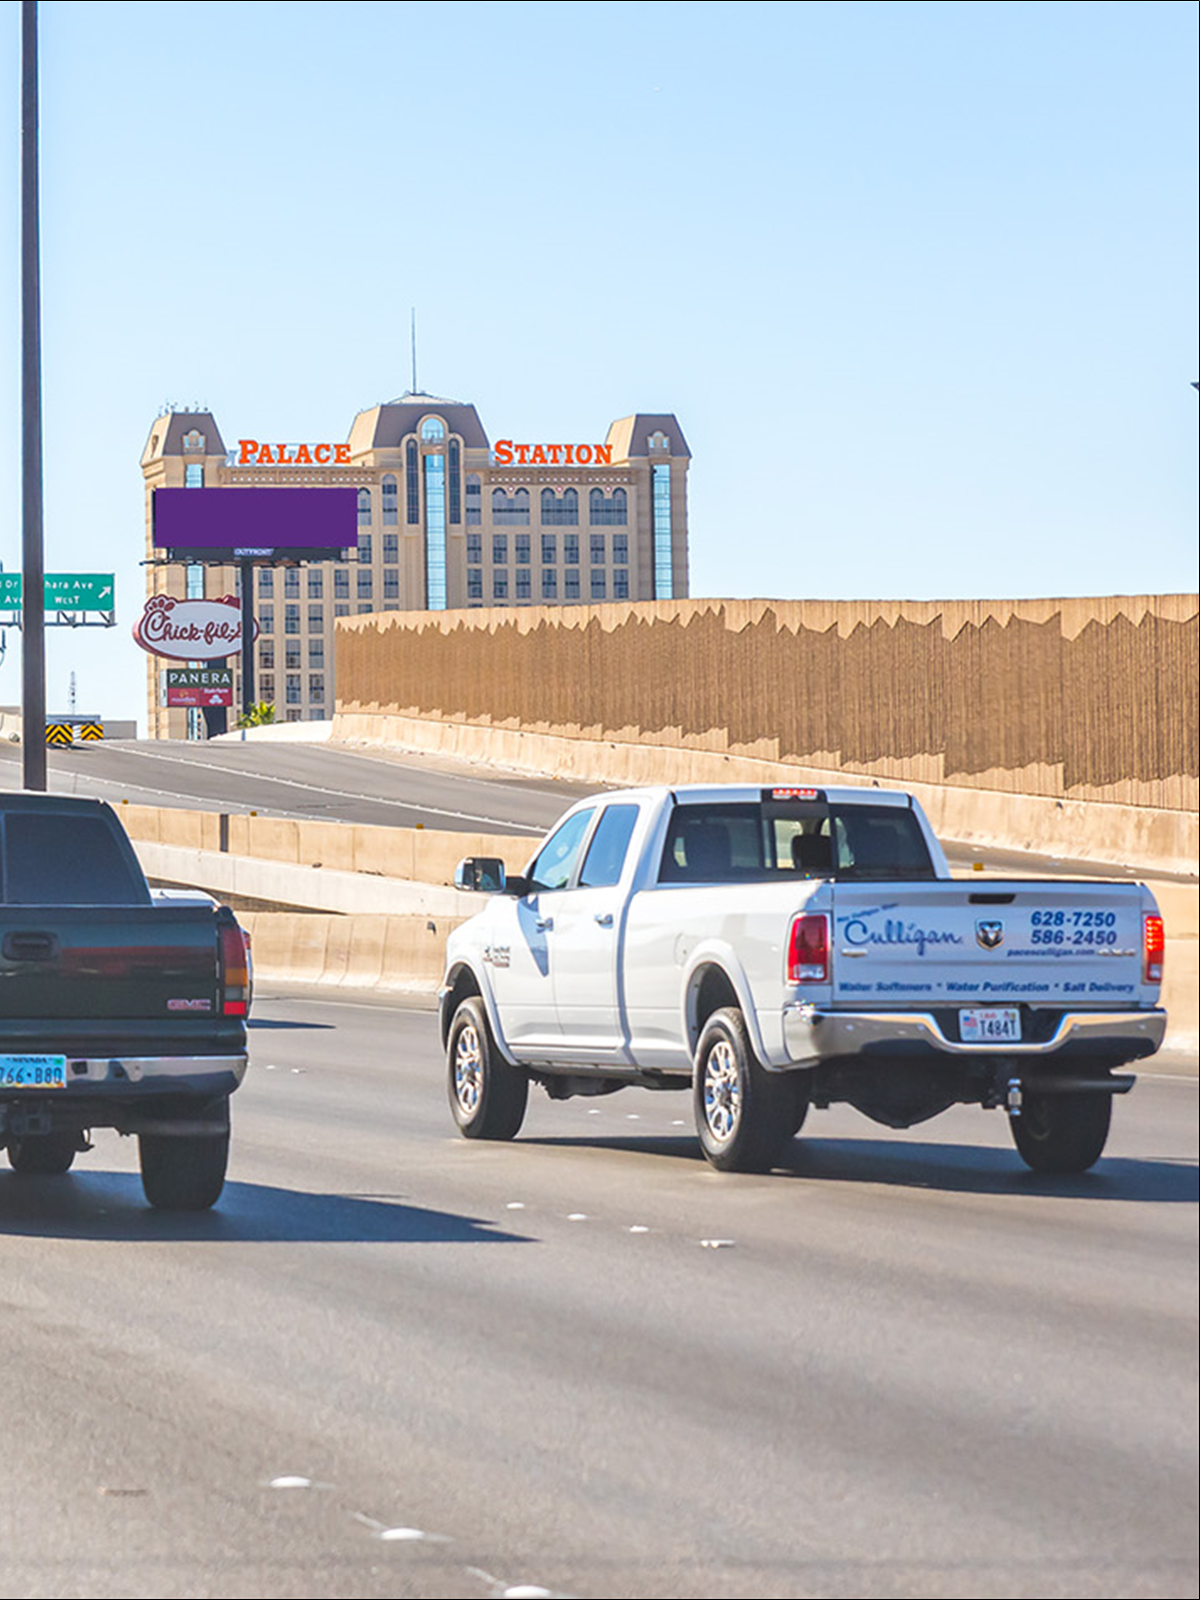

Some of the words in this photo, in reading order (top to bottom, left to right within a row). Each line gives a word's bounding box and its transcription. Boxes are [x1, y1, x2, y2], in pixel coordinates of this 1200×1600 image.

[238, 439, 352, 464] PALACE
[494, 439, 613, 465] STATION
[45, 580, 69, 590] hara
[72, 580, 94, 590] Ave
[169, 672, 231, 684] PANERA
[1030, 910, 1117, 927] 628-7250
[844, 919, 962, 956] Culligan
[1030, 929, 1118, 946] 586-2450
[946, 981, 980, 992] Water
[983, 981, 1049, 993] Purification
[1063, 981, 1086, 993] Salt
[1089, 982, 1135, 994] Delivery
[167, 998, 212, 1011] GMC
